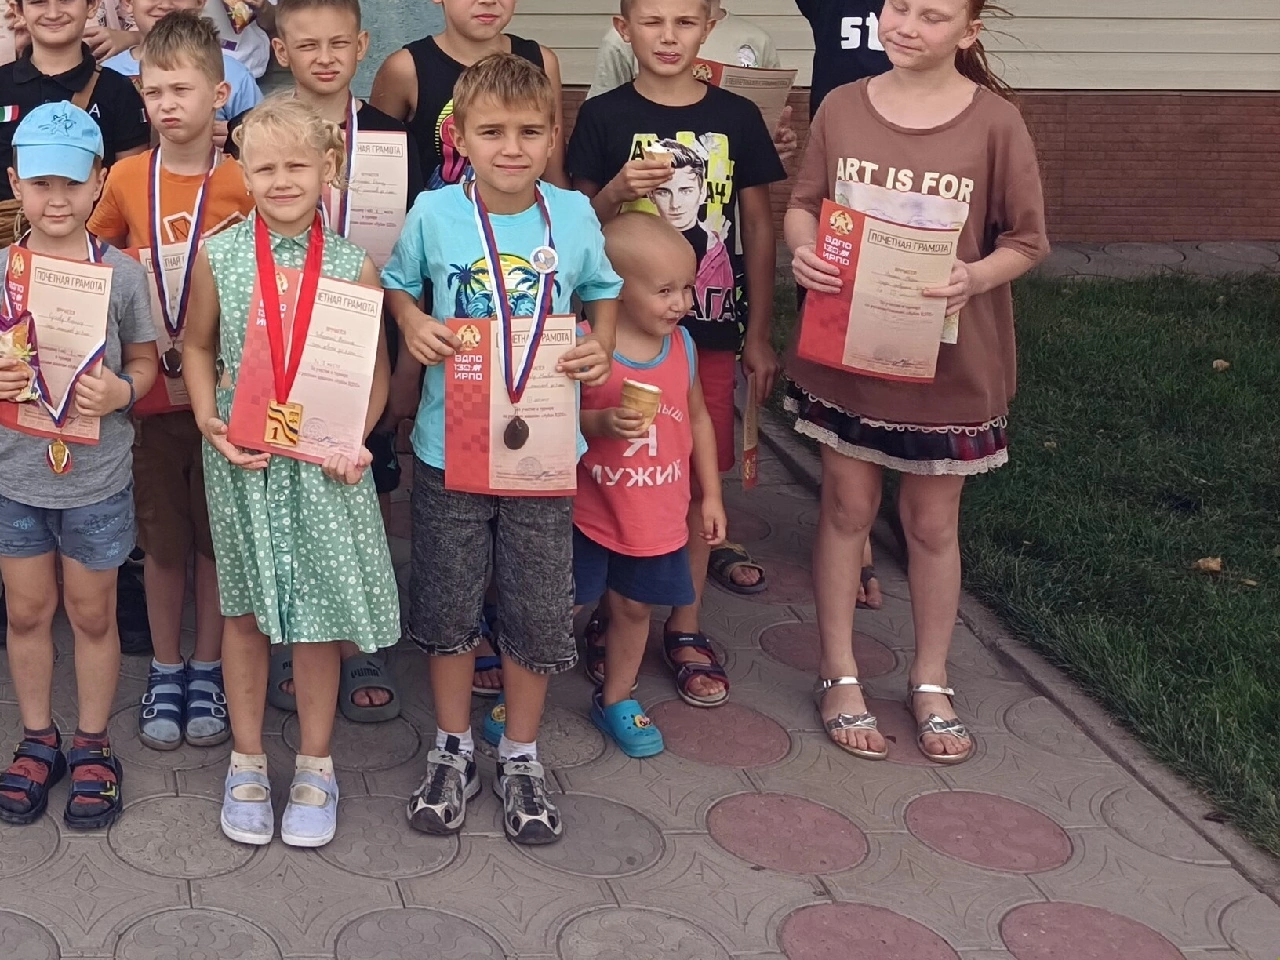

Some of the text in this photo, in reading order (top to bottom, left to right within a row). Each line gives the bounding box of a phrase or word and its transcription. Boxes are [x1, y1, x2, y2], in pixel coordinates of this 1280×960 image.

[837, 157, 974, 203] ART IS FOR
[824, 235, 853, 249] ВДПО
[871, 232, 950, 253] ПОЧЕТНАЯ ГРАМОТА
[822, 252, 850, 266] ИРПО
[36, 269, 104, 292] ПОЧЕТНАЯ ГРАМОТА
[345, 296, 375, 314] ГРАМОТА
[541, 332, 570, 342] РАМОТА
[454, 355, 483, 363] ВДПО
[454, 372, 483, 381] ИРПО
[623, 424, 657, 457] Я
[351, 667, 380, 678] PUMA
